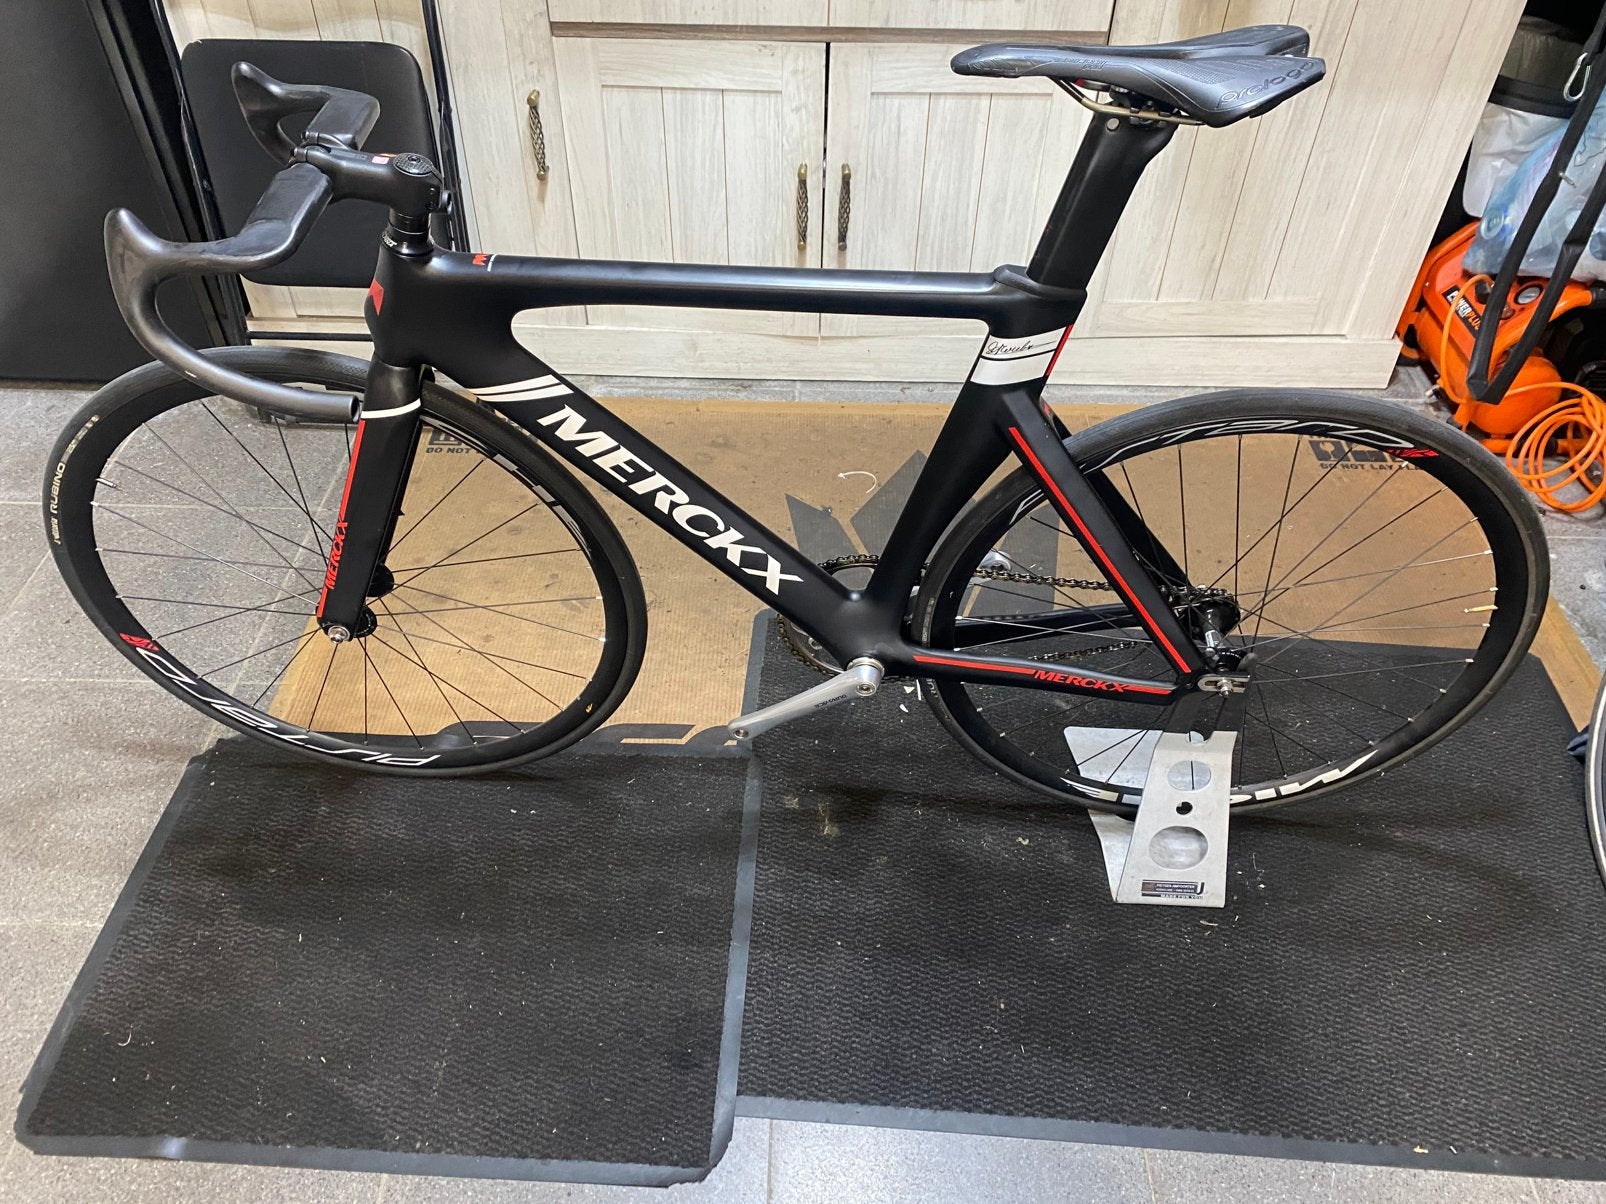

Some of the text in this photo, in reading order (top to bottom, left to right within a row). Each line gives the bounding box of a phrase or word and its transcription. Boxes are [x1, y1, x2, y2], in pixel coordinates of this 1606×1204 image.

[1446, 290, 1481, 330] PWERPLU
[50, 461, 67, 514] RUBINO
[1341, 462, 1366, 470] NOT
[1369, 462, 1394, 470] LAY
[536, 404, 804, 595] MERCKX
[325, 519, 348, 590] MERCKX
[1034, 669, 1130, 692] MERCKX
